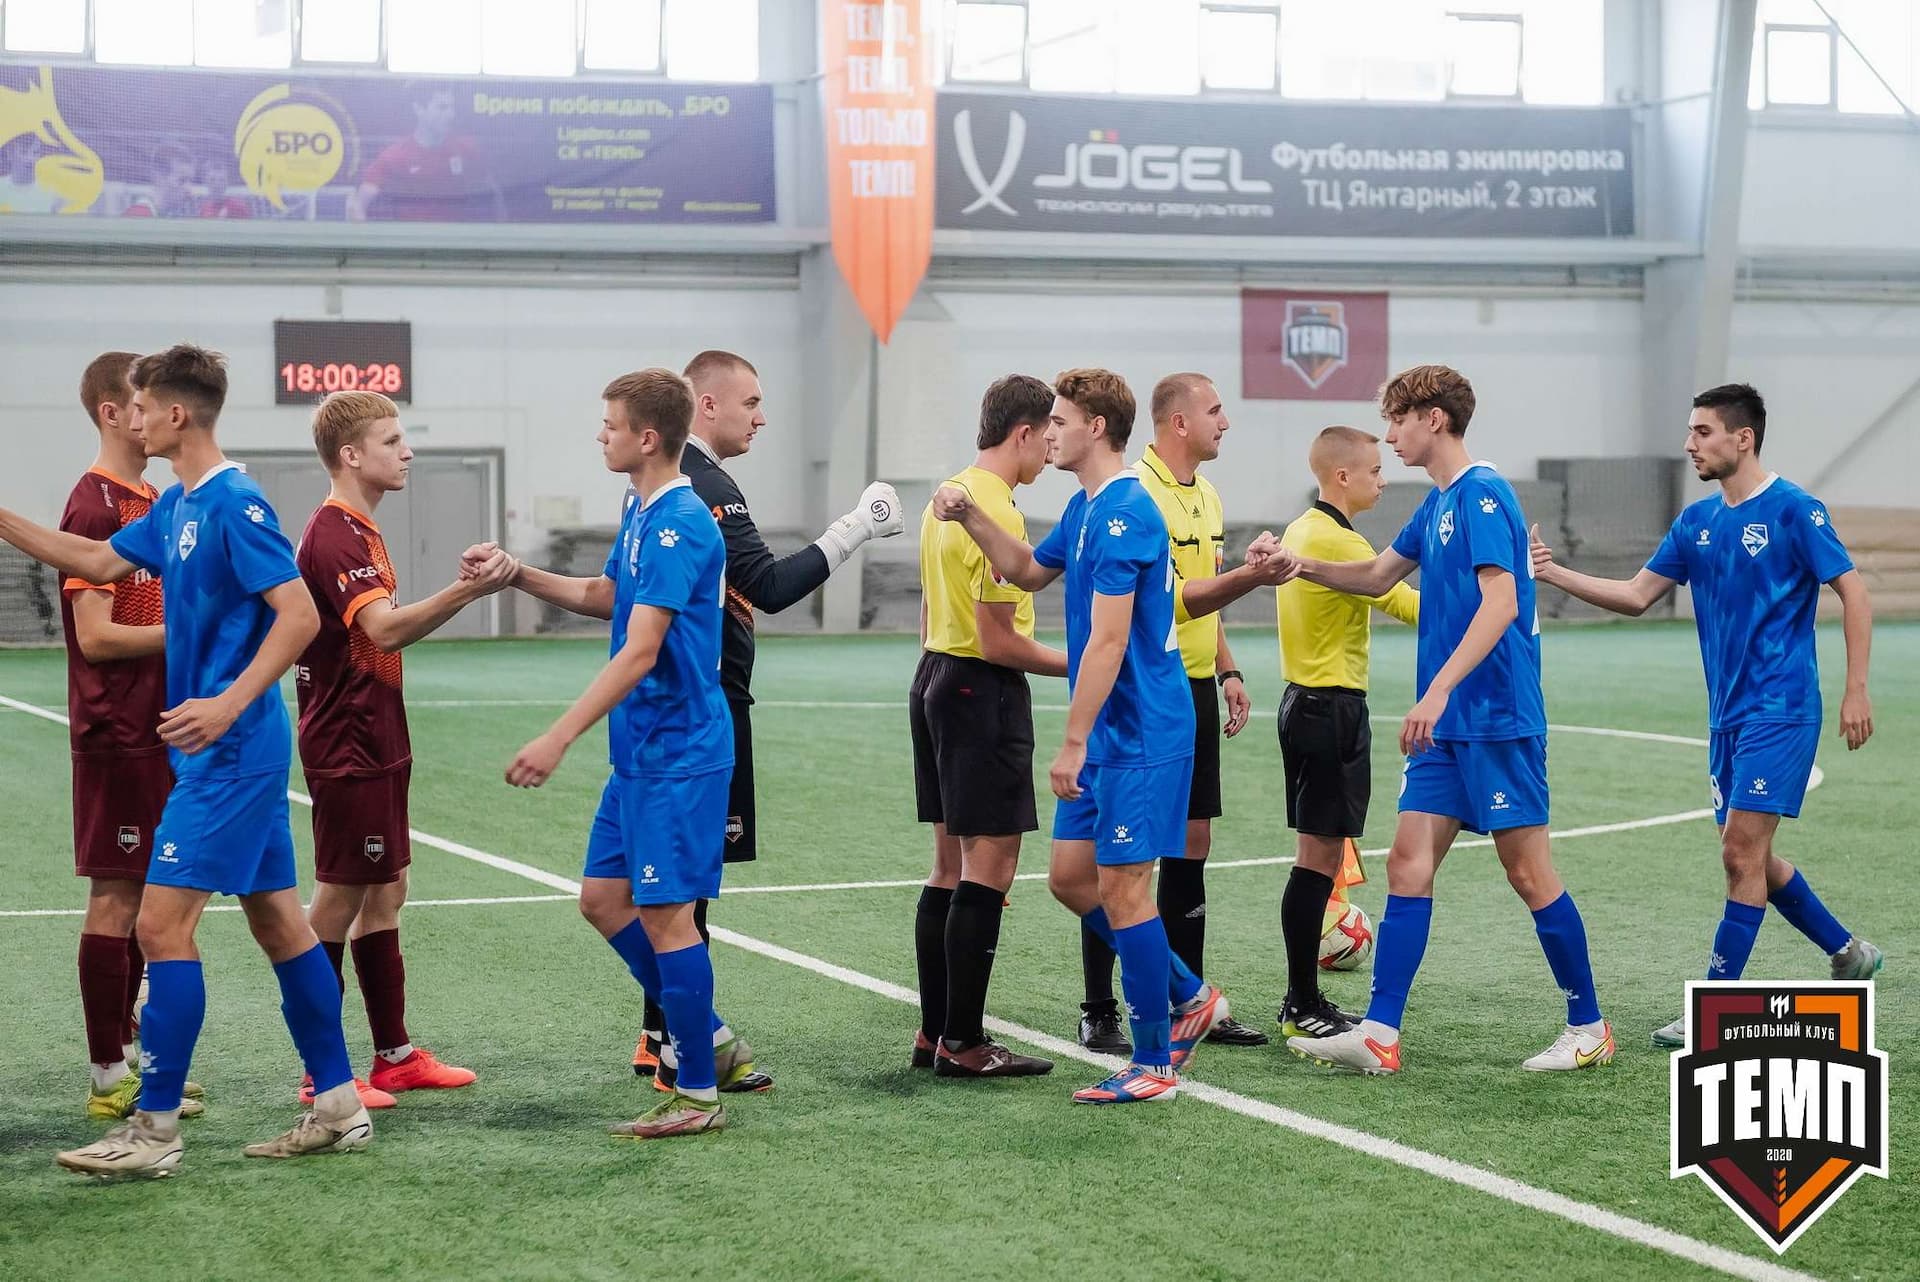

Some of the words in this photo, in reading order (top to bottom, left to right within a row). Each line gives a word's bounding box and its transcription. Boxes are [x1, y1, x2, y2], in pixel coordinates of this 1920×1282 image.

[473, 93, 543, 116] Время
[550, 95, 673, 119] побеждать,
[265, 131, 333, 156] .БРО
[835, 108, 926, 145] ТОЛЬКО
[1033, 129, 1273, 192] JÖGEL
[1271, 141, 1449, 174] Футбольная
[1456, 148, 1625, 176] экипировка
[849, 160, 915, 197] ТЕМП!
[1034, 199, 1155, 214] технологии
[1157, 202, 1273, 218] результата
[1302, 179, 1342, 211] ТЦ
[1349, 179, 1498, 213] Янтарный,
[1504, 180, 1521, 208] 2
[1528, 185, 1597, 208] этаж
[281, 362, 402, 392] 18:00:28
